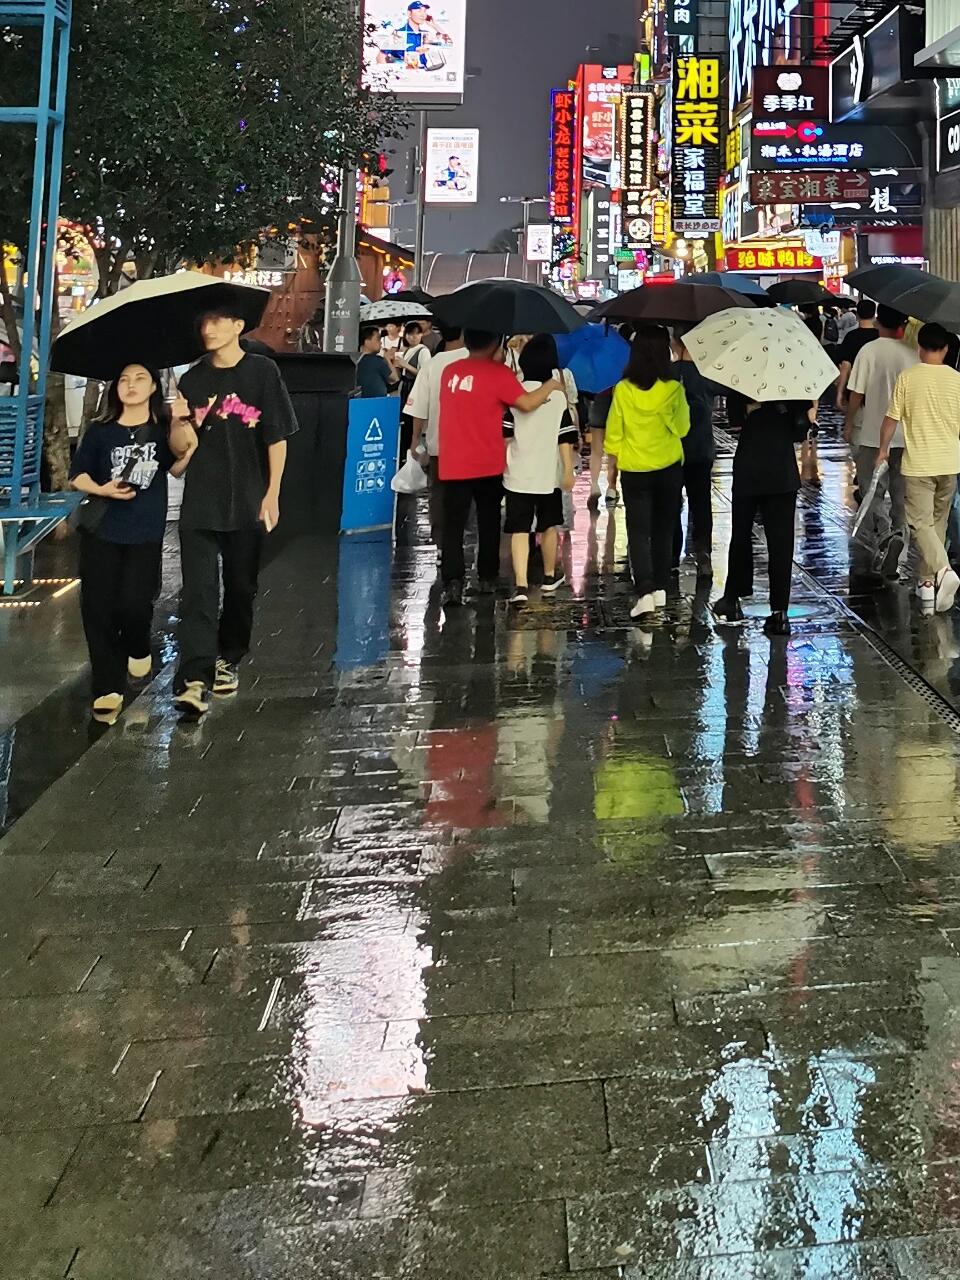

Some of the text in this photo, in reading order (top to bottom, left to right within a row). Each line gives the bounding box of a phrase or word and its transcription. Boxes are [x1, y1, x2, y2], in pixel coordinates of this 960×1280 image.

[675, 56, 719, 146] 湘菜
[763, 94, 815, 112] 季季红
[683, 147, 706, 217] 家福堂
[597, 200, 610, 263] SEMIR
[737, 250, 814, 269] 绝味鸭脖
